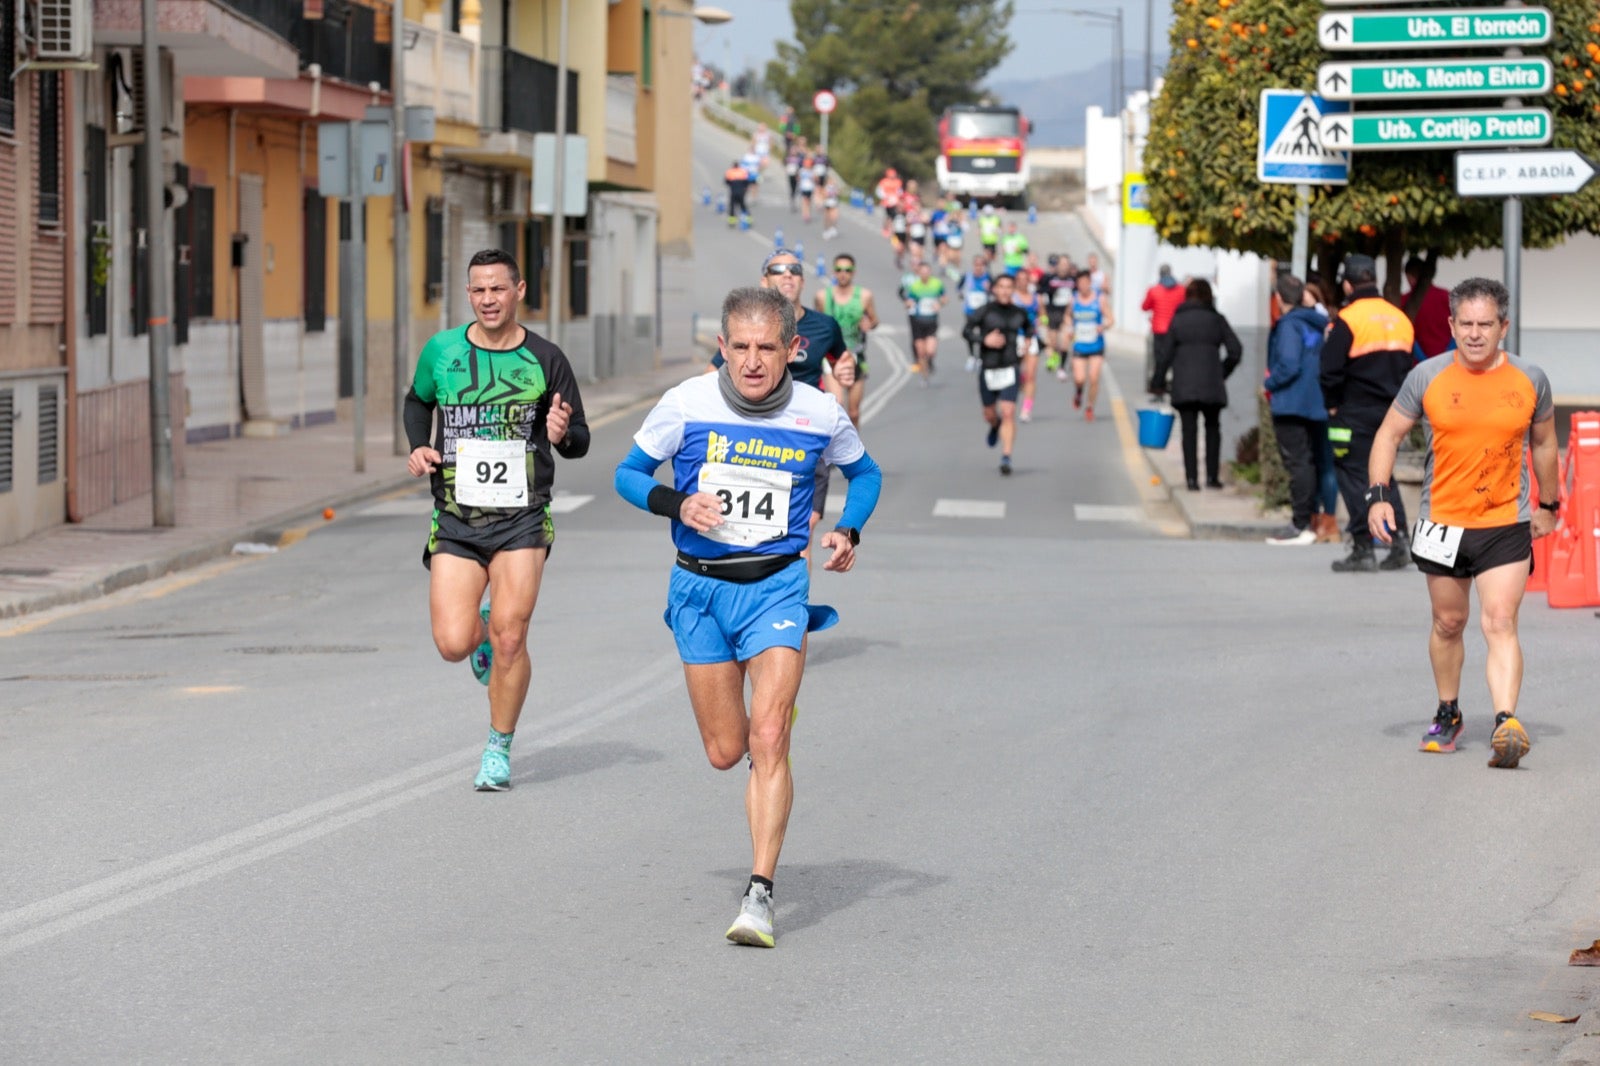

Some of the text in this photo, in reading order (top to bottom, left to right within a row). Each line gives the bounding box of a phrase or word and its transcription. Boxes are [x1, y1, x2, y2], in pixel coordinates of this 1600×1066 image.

[1407, 14, 1540, 38] Urb. El torreón
[1382, 66, 1540, 89] Urb. Monte Elvira
[1377, 116, 1541, 141] Urb. Cortijo Pretel
[1518, 163, 1576, 178] ABADÍA
[441, 405, 477, 427] TEAM
[730, 454, 778, 469] deportes
[734, 438, 806, 464] olimpo
[476, 461, 508, 485] 92
